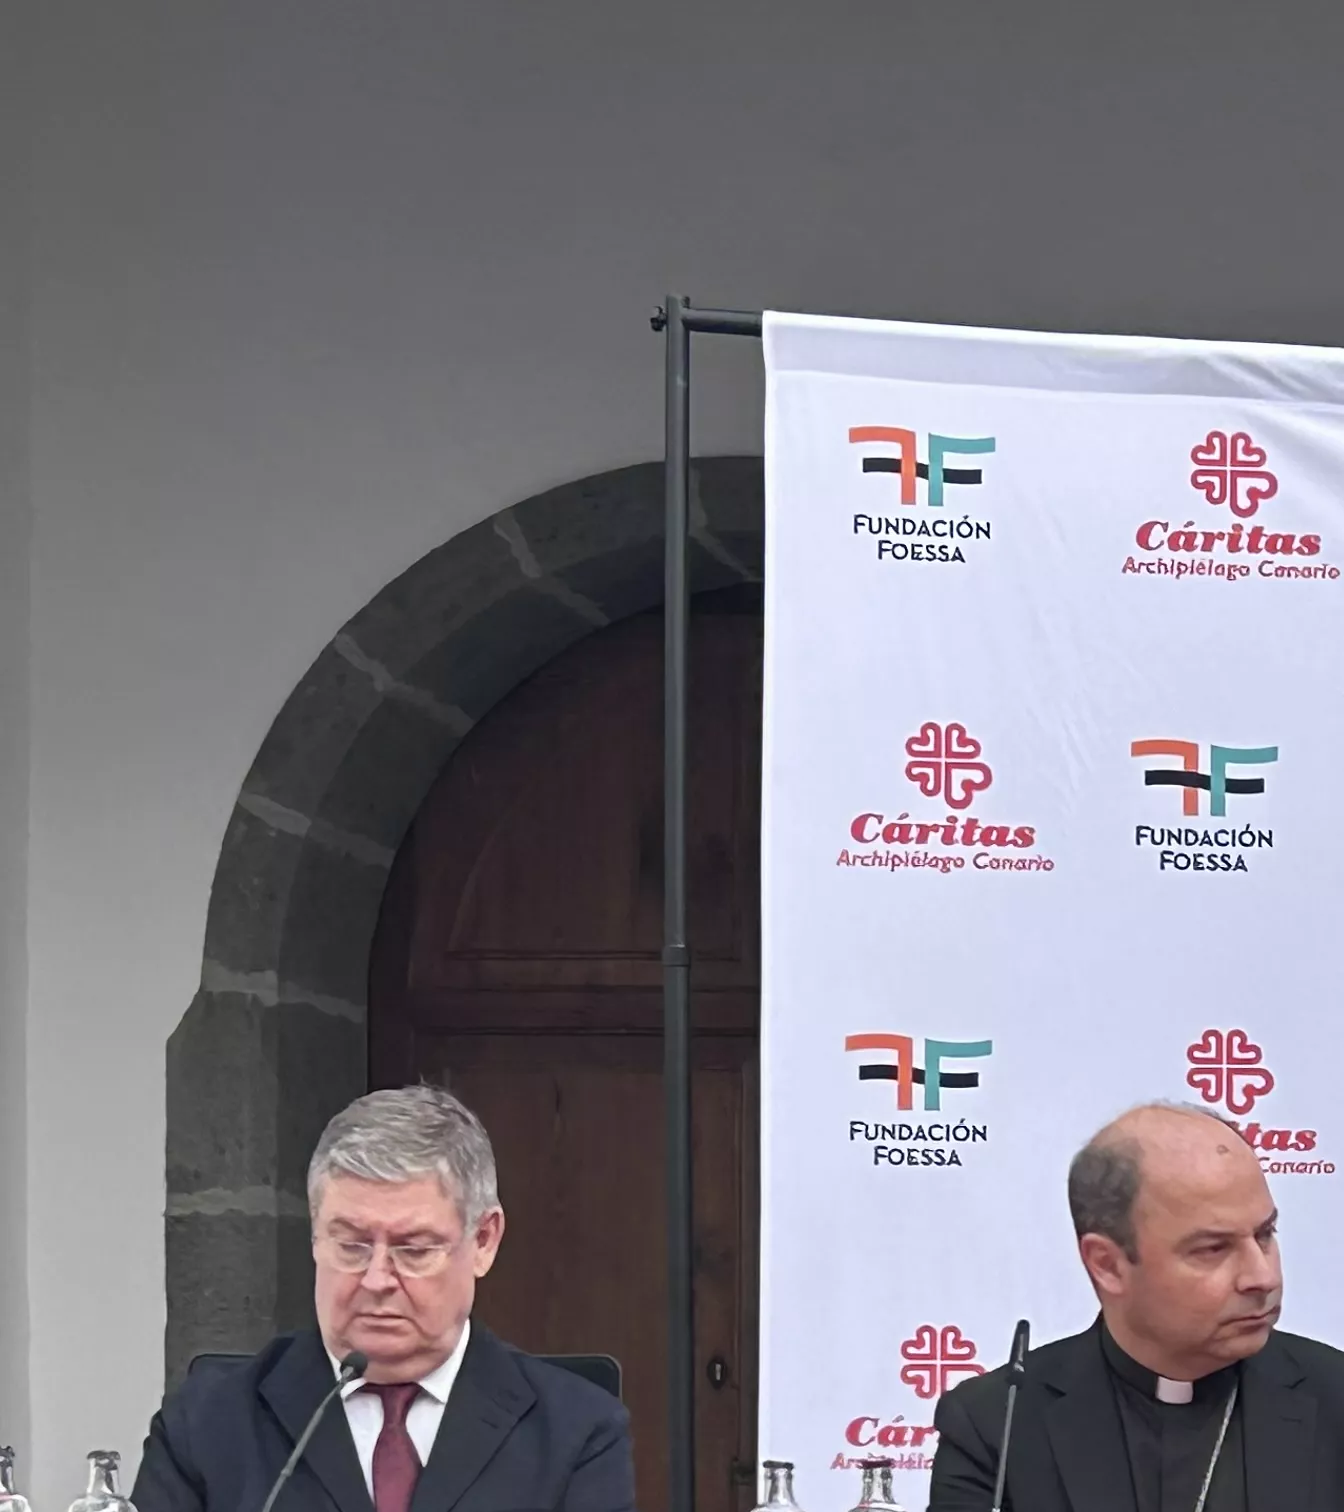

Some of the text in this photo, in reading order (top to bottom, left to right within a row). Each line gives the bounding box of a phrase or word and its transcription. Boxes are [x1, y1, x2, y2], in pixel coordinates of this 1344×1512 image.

[854, 514, 991, 539] FUNDACIÓN
[1136, 521, 1321, 556] Cáritas
[878, 540, 966, 563] FOESSA
[1122, 556, 1340, 581] Archipiélago Canario
[851, 813, 1036, 848] Cáritas
[1136, 823, 1273, 848] FUNDACIÓN
[836, 849, 1054, 873] Archipiélago Canario
[1160, 850, 1248, 872] FOESSA
[850, 1118, 987, 1142] FUNDACIÓN
[873, 1145, 962, 1166] FOESSA
